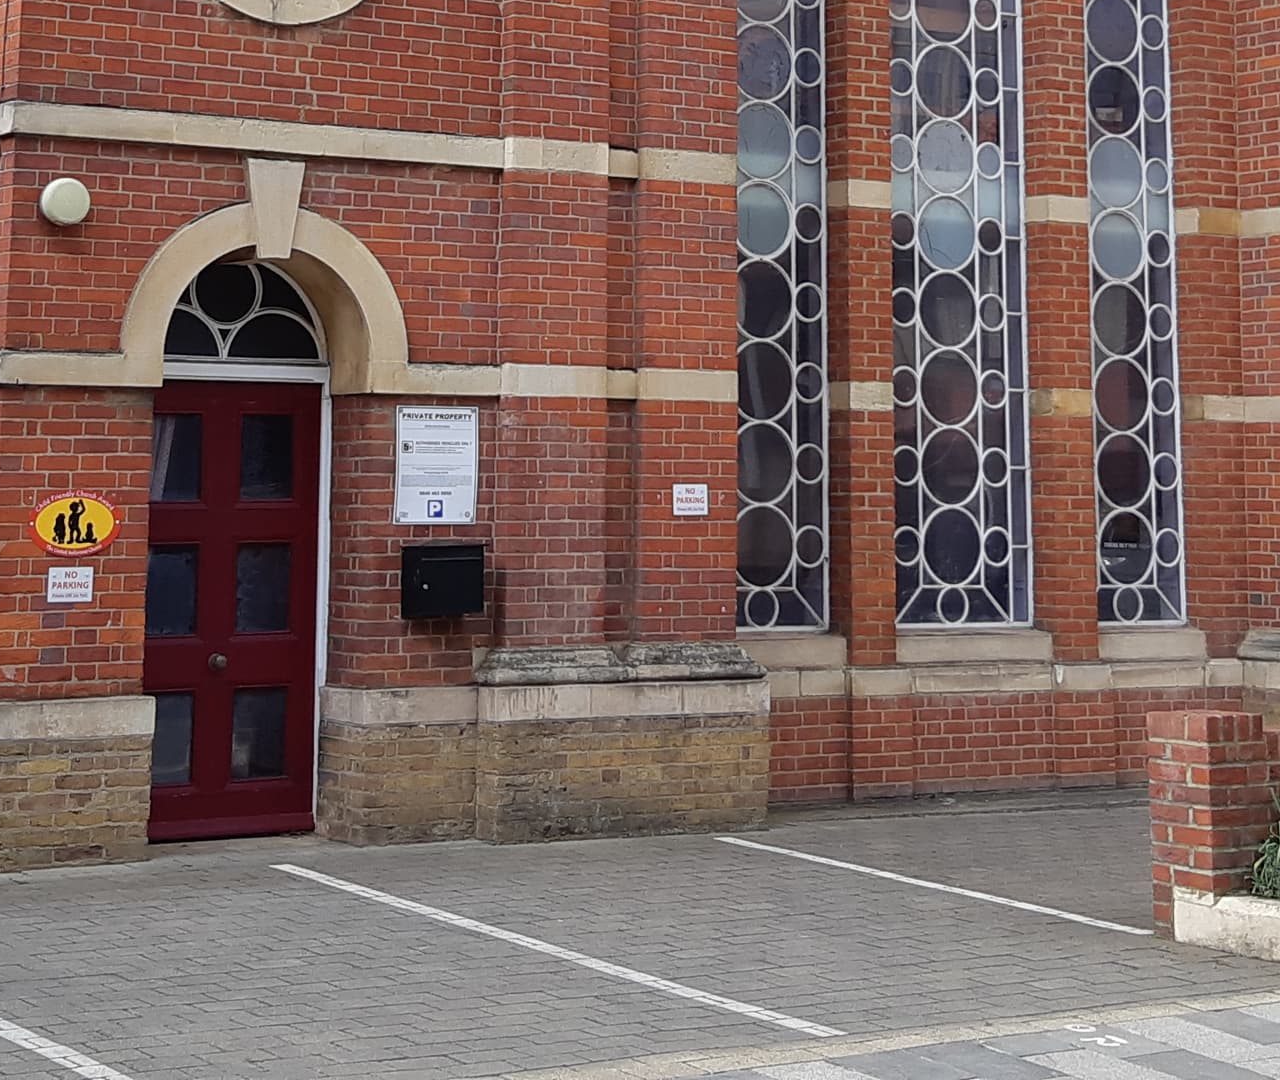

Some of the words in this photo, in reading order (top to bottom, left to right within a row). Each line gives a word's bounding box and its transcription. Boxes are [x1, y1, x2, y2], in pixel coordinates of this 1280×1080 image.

[35, 497, 51, 512] Child
[50, 490, 75, 503] Friendly
[64, 571, 78, 579] NO
[51, 581, 89, 590] PARKING
